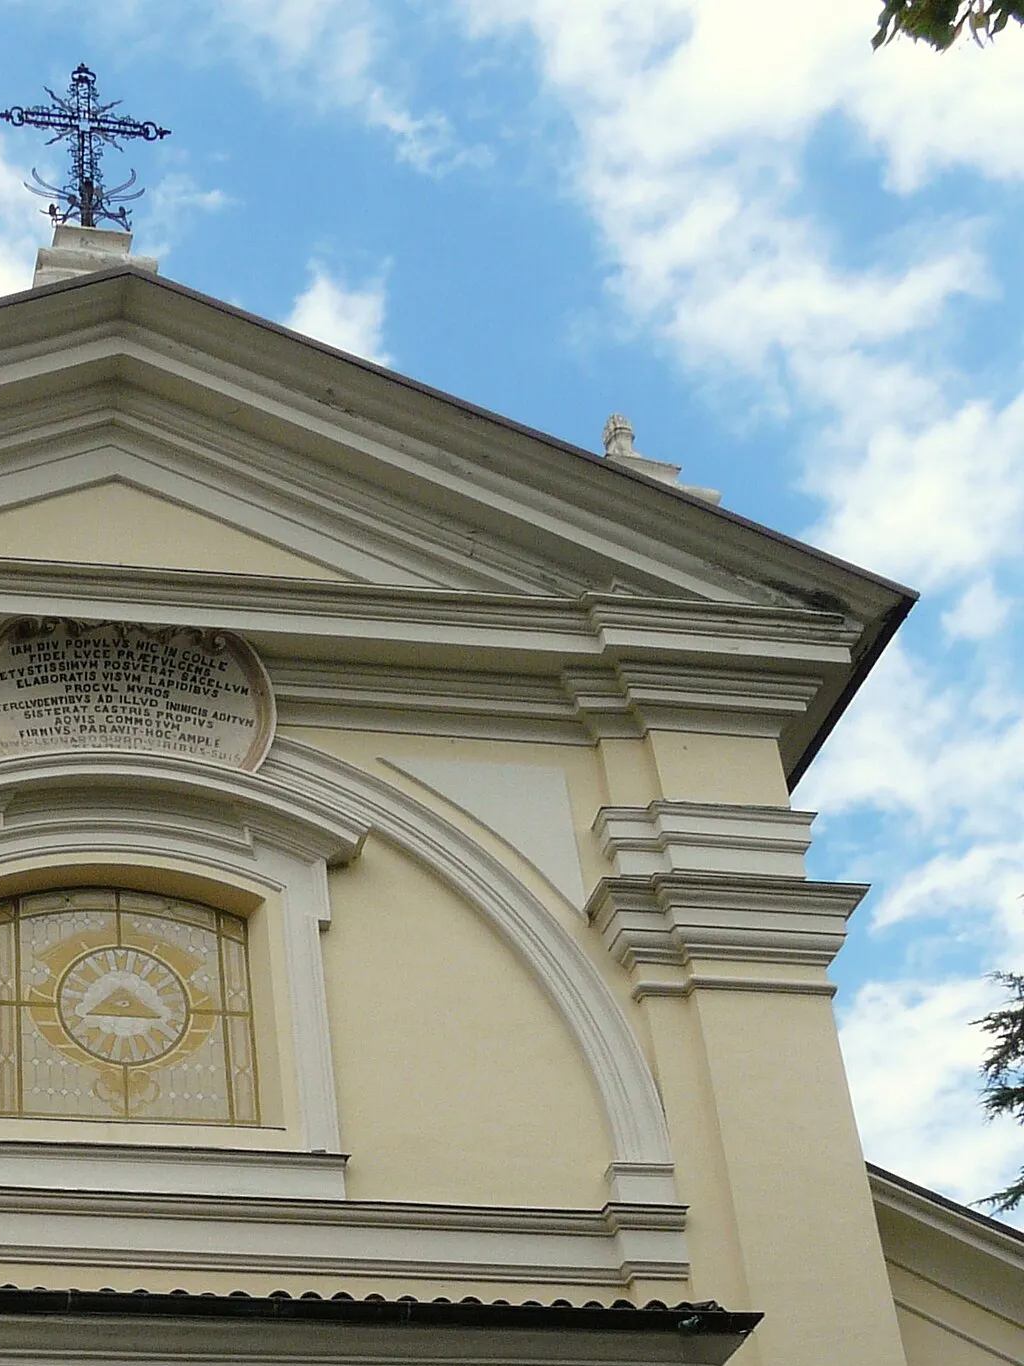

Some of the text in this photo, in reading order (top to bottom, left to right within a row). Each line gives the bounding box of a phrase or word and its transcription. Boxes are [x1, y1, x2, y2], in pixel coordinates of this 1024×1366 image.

[11, 639, 228, 672] IAM DIV POPVLVS HIC IN COLLE
[29, 651, 65, 663] FIDEI
[74, 649, 111, 659] LVCE
[17, 672, 219, 698] ELABORATIS VISVM LAPIDIBVS
[104, 660, 174, 678] POSVERAT
[181, 671, 249, 696] SACELLVM
[65, 683, 170, 699] PROCVL MVROS
[24, 705, 214, 729] SISTERAT CASTRIS PROPIVS
[55, 715, 180, 731] AQVIS COMMOTVM
[97, 695, 112, 703] AD
[119, 695, 158, 707] ILLVD
[165, 701, 208, 717] INIMICIS
[212, 711, 254, 727] ADITVM
